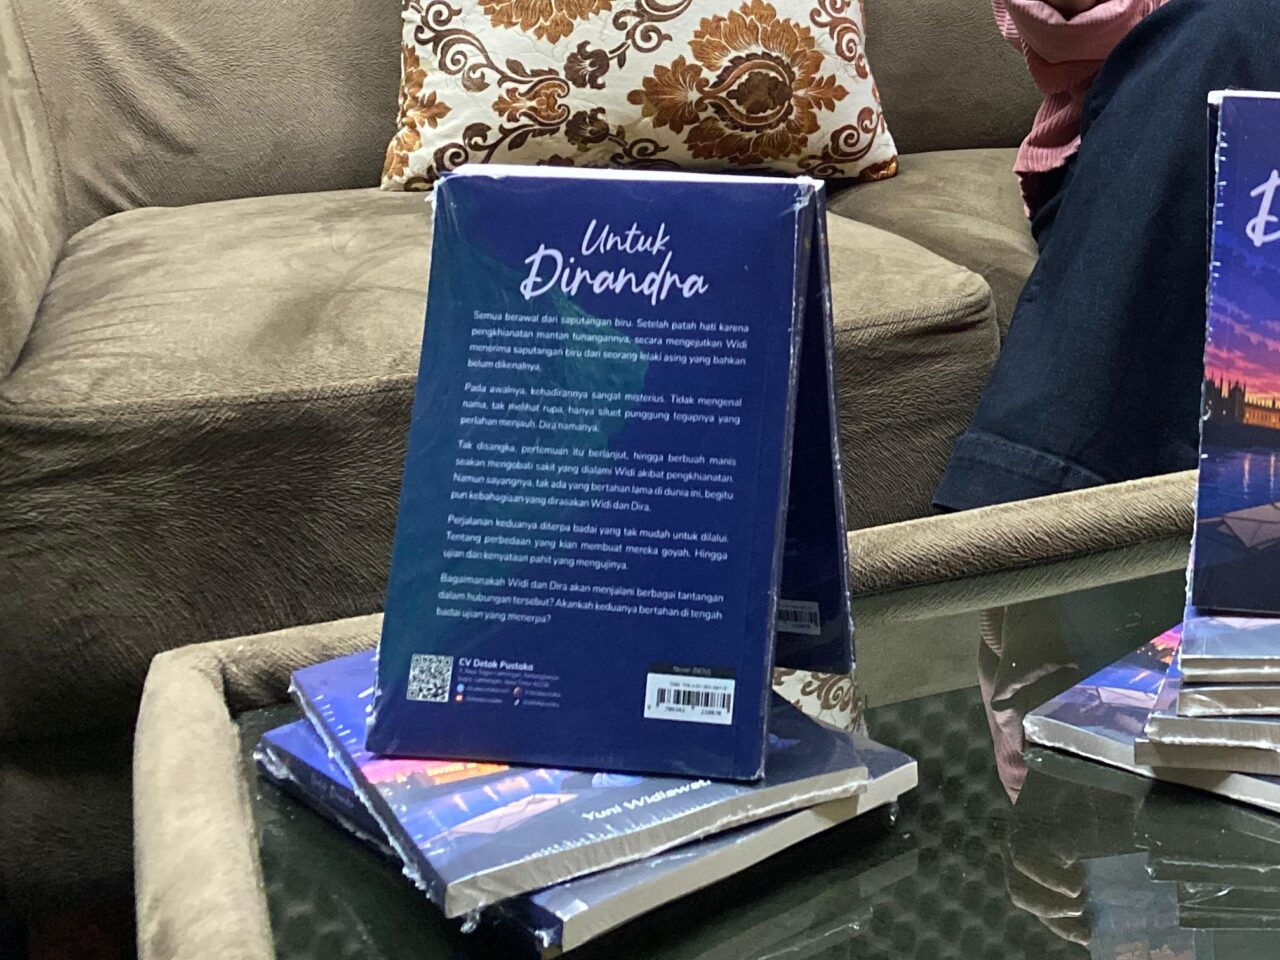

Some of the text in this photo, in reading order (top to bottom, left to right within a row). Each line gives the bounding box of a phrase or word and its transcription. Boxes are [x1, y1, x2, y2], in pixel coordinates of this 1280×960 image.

[581, 219, 671, 258] Untuk
[520, 242, 708, 305] Dirandra
[474, 310, 502, 319] Semua
[504, 313, 538, 321] berawal
[541, 314, 557, 322] dari
[560, 315, 611, 326] saputangan
[636, 319, 668, 327] Setelah
[699, 322, 716, 330] hati
[471, 328, 533, 337] pengkhianatan
[635, 336, 662, 345] secara
[666, 338, 722, 347] mengejutkan
[726, 339, 747, 348] Widi
[467, 359, 493, 367] belum
[469, 344, 511, 352] menerima
[513, 347, 563, 356] saputangan
[565, 347, 582, 357] biru
[584, 349, 600, 357] dari
[603, 352, 637, 360] seorang
[663, 354, 687, 363] asing
[689, 356, 710, 365] yang
[712, 356, 745, 364] bahkan
[464, 382, 486, 392] Pada
[530, 388, 588, 398] kehadirannya
[592, 392, 620, 400] sangat
[670, 394, 694, 403] Tidak
[697, 398, 742, 406] mengenal
[491, 401, 504, 409] tak
[568, 406, 594, 415] hanya
[624, 411, 669, 420] punggung
[673, 412, 714, 422] tegapnya
[718, 416, 740, 424] yang
[458, 439, 472, 448] Tak
[521, 445, 568, 454] pertemuan
[572, 447, 584, 456] itu
[633, 452, 663, 462] hingga
[668, 454, 704, 463] berbuah
[487, 460, 533, 469] mengobati
[557, 465, 578, 474] yang
[580, 465, 612, 474] dialami
[614, 467, 635, 476] Widi
[637, 469, 664, 477] akibat
[452, 473, 484, 482] Namun
[536, 479, 548, 487] tak
[550, 480, 566, 488] ada
[568, 483, 589, 491] yang
[590, 483, 630, 492] bertahan
[631, 485, 652, 494] lama
[654, 486, 662, 494] di
[664, 488, 688, 496] dunia
[704, 490, 733, 500] begitu
[524, 496, 546, 505] yang
[547, 497, 589, 506] dirasakan
[590, 499, 611, 508] Widi
[447, 514, 493, 525] Perjalanan
[495, 519, 537, 529] keduanya
[540, 522, 570, 531] diterpa
[599, 527, 620, 536] yang
[639, 530, 670, 538] mudah
[446, 531, 481, 543] Tentang
[483, 536, 531, 544] perbedaan
[534, 540, 556, 548] yang
[558, 540, 577, 548] kian
[580, 543, 622, 551] membuat
[625, 546, 658, 554] mereka
[694, 549, 727, 560] Hingga
[529, 555, 551, 563] pahit
[553, 558, 574, 566] yang
[508, 578, 528, 587] Widi
[569, 583, 590, 591] akan
[592, 586, 634, 595] menjalani
[636, 588, 675, 599] berbagai
[677, 592, 723, 602] tantangan
[438, 591, 465, 599] dalam
[466, 593, 511, 603] hubungan
[555, 599, 593, 608] Akankah
[594, 602, 637, 613] keduanya
[638, 606, 679, 615] bertahan
[680, 608, 689, 616] di
[690, 610, 722, 619] tengah
[484, 612, 506, 621] yang
[459, 658, 534, 671] CV Detak Pustaka
[581, 805, 623, 821] Yuni
